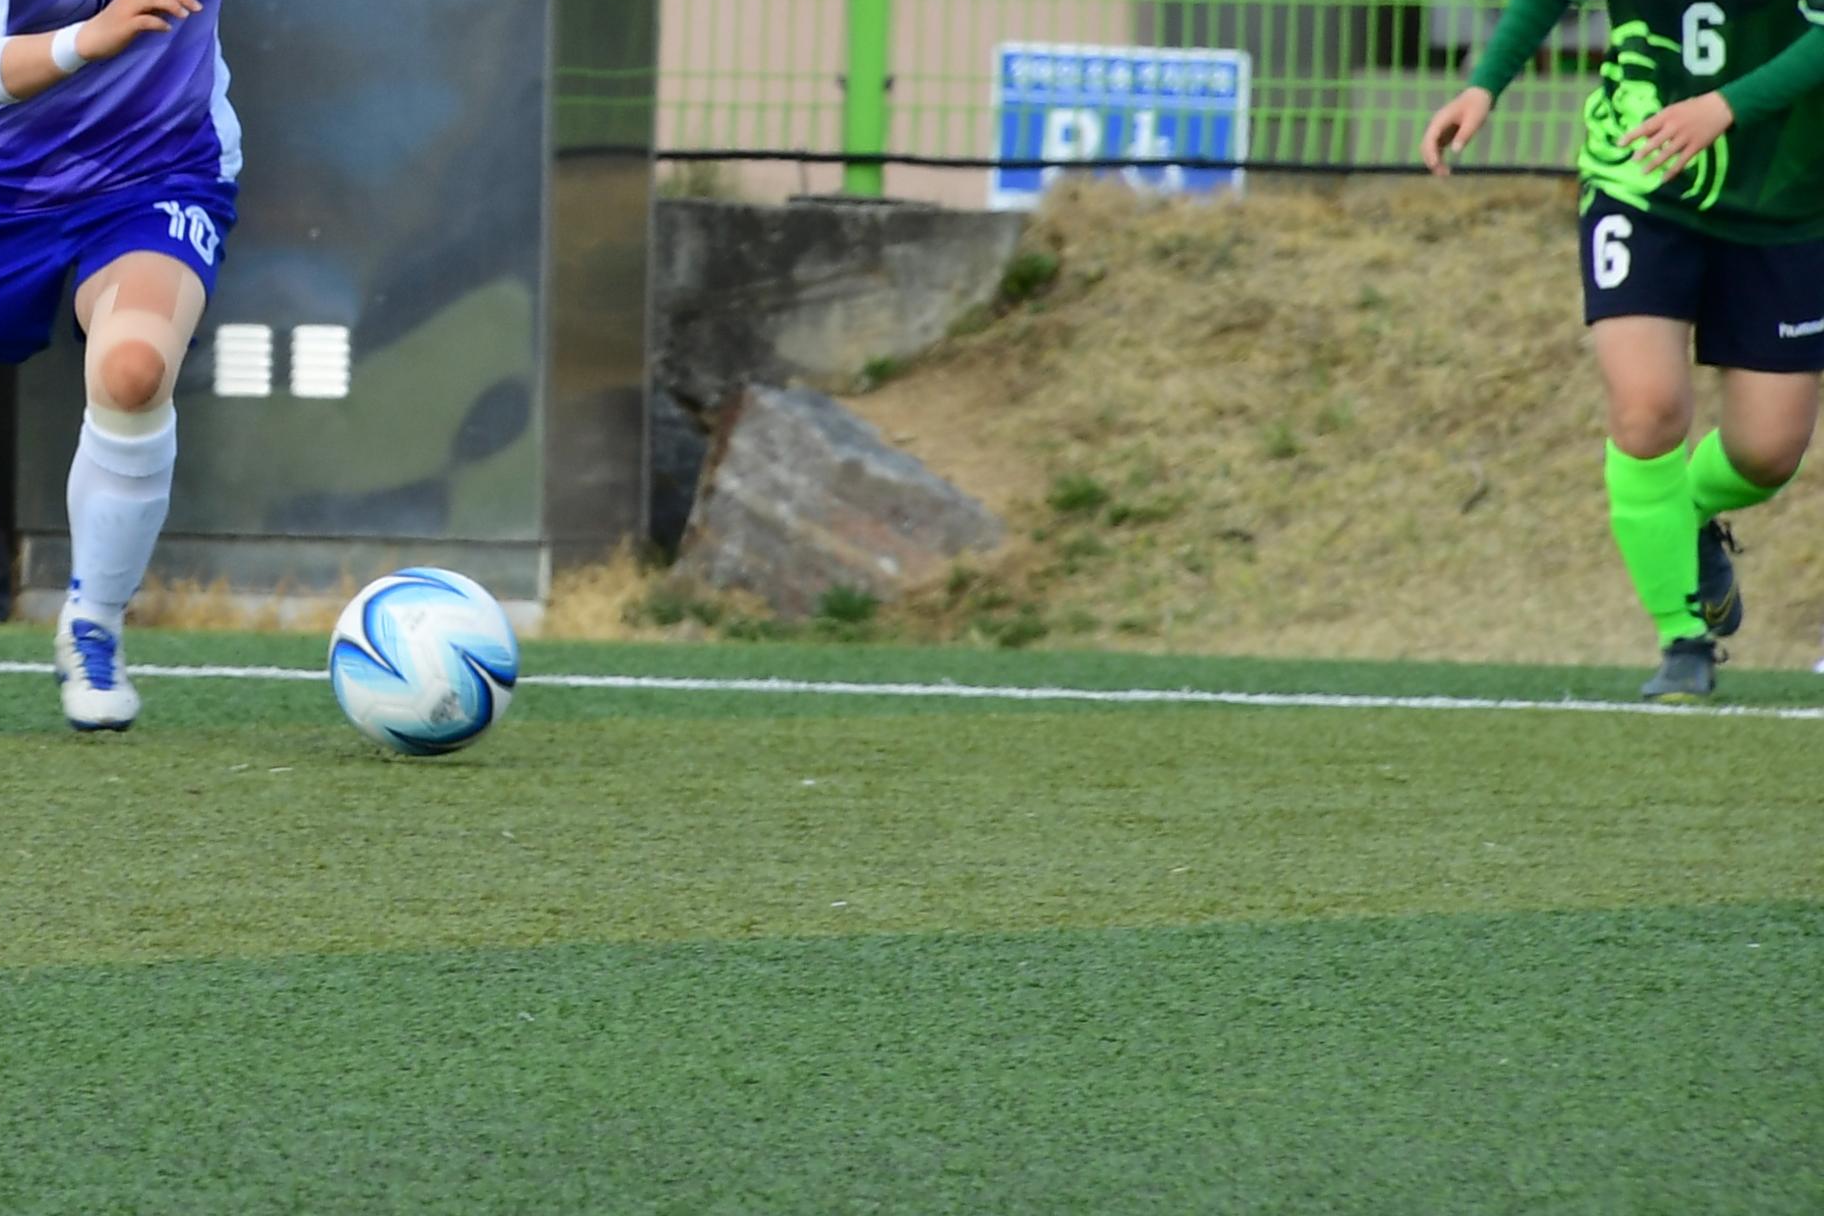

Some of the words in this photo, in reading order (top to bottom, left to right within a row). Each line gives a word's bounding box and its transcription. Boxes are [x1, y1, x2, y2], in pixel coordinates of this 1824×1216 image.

[1682, 2, 1726, 76] 6
[153, 200, 221, 266] 10
[1593, 214, 1633, 289] 6
